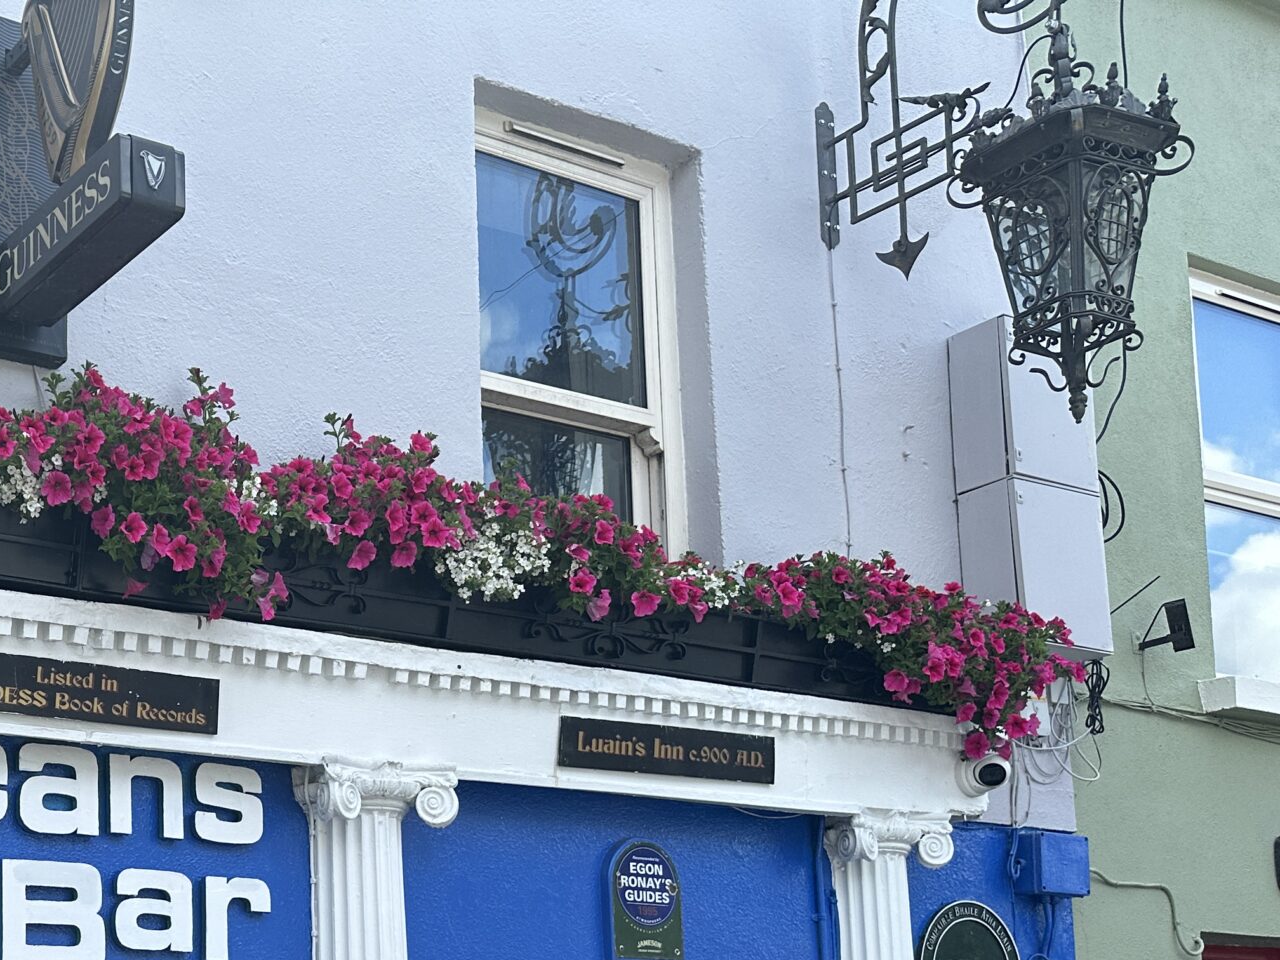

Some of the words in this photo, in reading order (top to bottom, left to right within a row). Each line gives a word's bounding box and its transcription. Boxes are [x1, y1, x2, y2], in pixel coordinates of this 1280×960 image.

[35, 665, 94, 690] Listed
[100, 673, 119, 692] in
[54, 692, 105, 715] Book
[111, 700, 129, 718] of
[135, 701, 207, 726] Records
[576, 730, 646, 757] Luain's
[652, 737, 684, 761] Inn
[629, 861, 664, 876] EGON
[620, 875, 673, 890] RONAY'S
[624, 889, 670, 904] GUIDES
[637, 939, 663, 949] JAMESON
